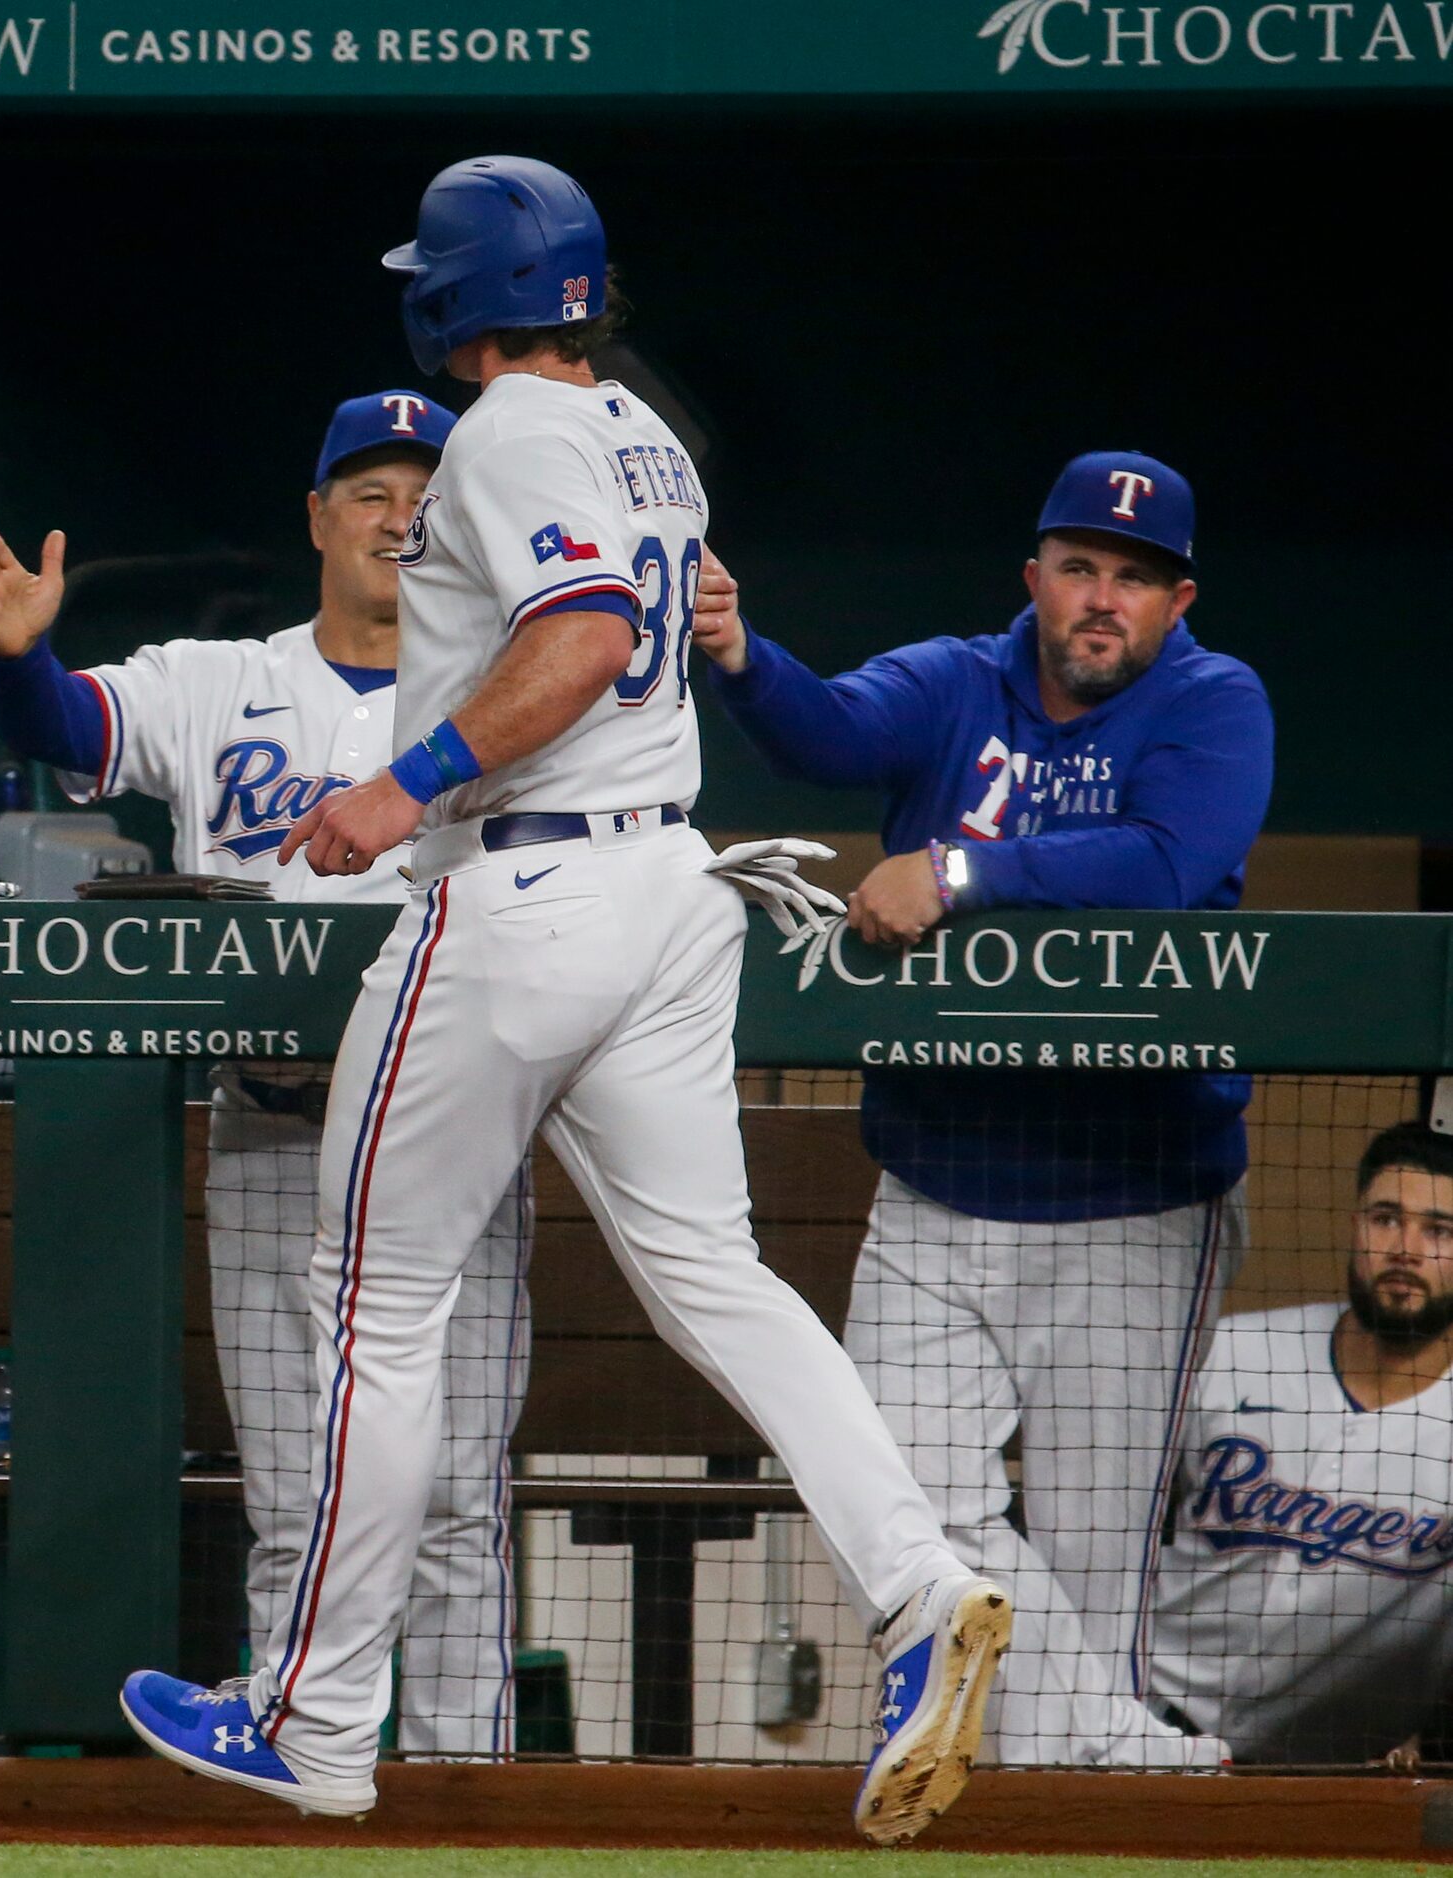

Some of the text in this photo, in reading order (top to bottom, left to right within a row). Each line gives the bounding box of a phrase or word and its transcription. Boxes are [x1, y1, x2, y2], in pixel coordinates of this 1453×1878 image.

[101, 28, 591, 63] CASINOS & RESORTS
[563, 276, 589, 302] 38
[383, 394, 428, 434] T
[1109, 470, 1153, 521] T
[828, 917, 1270, 990] CHOCTAW
[106, 1029, 128, 1054] &
[141, 1029, 300, 1056] RESORTS
[861, 1040, 1236, 1069] CASINOS & RESORTS
